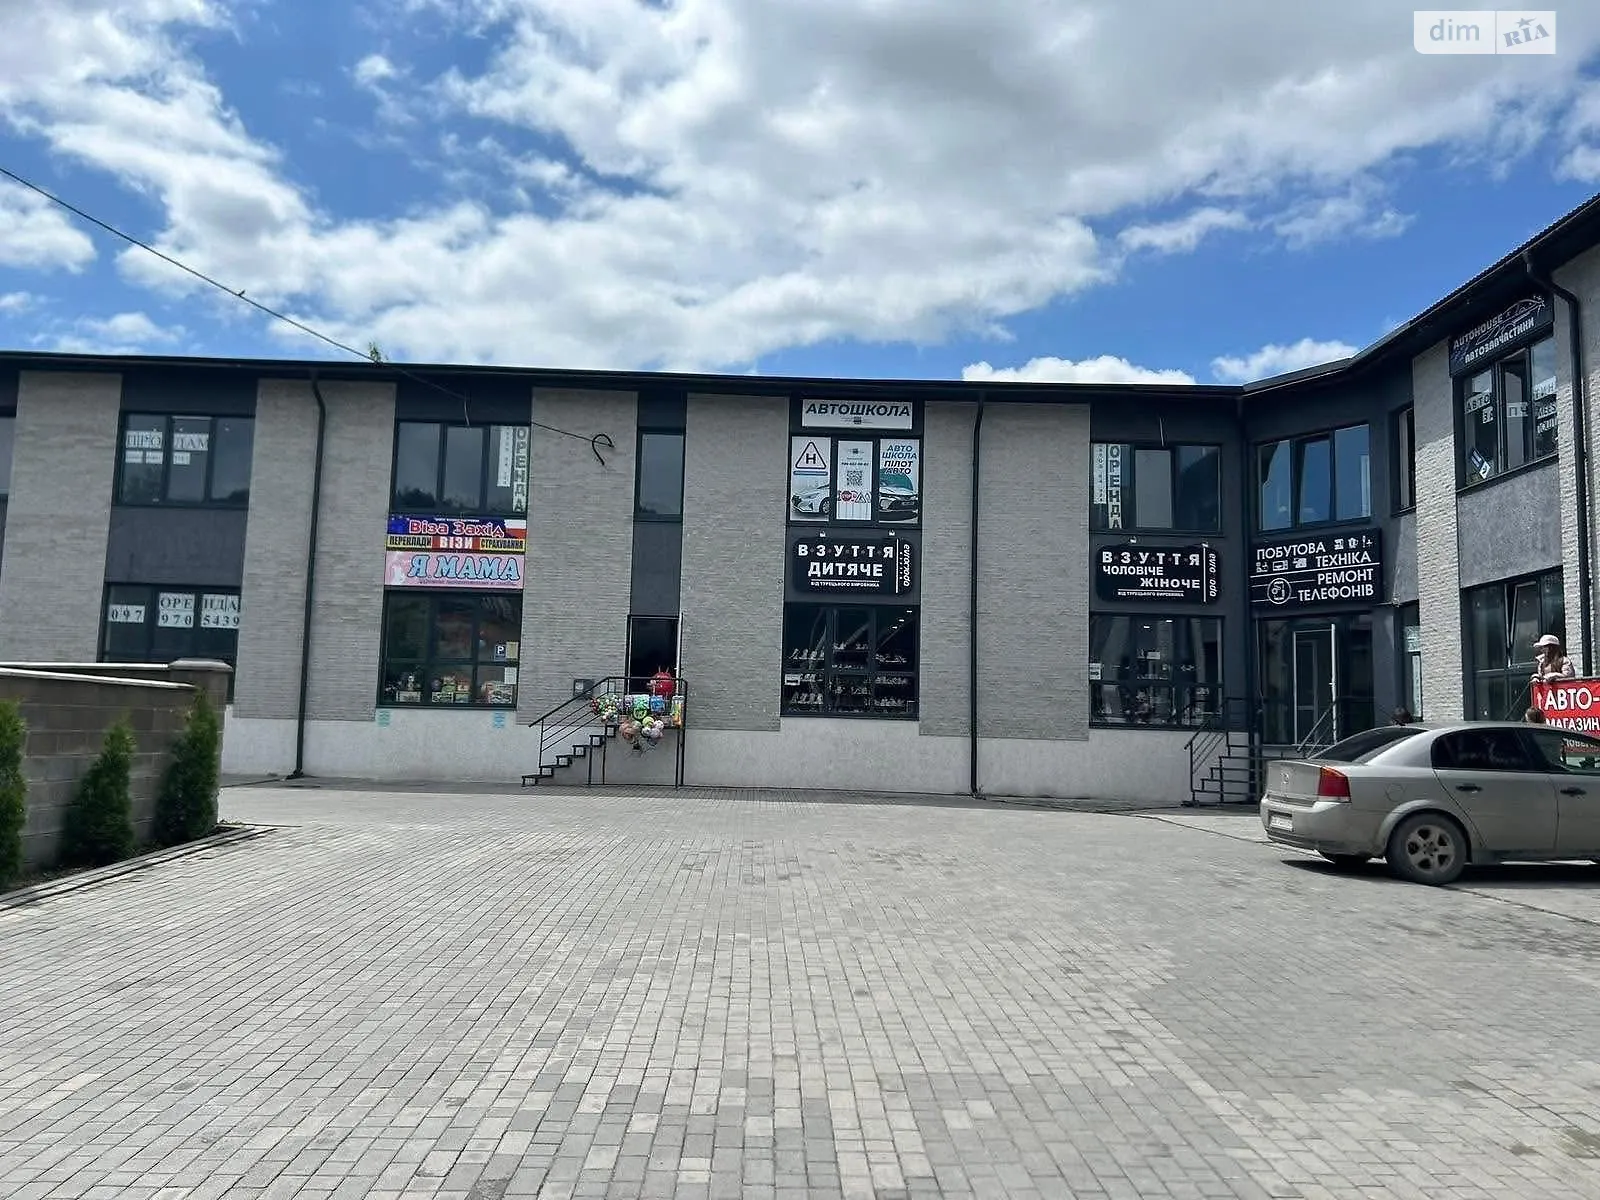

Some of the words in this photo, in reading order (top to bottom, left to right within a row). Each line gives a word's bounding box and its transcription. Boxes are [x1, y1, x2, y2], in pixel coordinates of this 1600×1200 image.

[1453, 313, 1504, 349] AUTOHOUSE
[1465, 317, 1535, 364] АВТОЗАПЧАСТИНИ
[806, 403, 910, 417] АВТОШКОЛА
[882, 452, 917, 460] ШКОЛА
[884, 460, 913, 468] ПІЛОТ
[1109, 445, 1121, 529] ОРЕНДА
[409, 520, 448, 535] Віза
[452, 519, 505, 538] Захід
[389, 536, 432, 547] ПЕРЕКЛАДИ
[439, 536, 473, 549] ВІЗИ
[481, 539, 523, 550] СТРАХУВАННЯ
[1257, 541, 1326, 560] ПОБУТОВА
[407, 555, 431, 579] Я
[434, 555, 520, 581] МАМА
[1315, 551, 1371, 568] ТЕХНІКА
[808, 562, 883, 577] ДИТЯЧЕ
[1103, 566, 1164, 576] ЧОЛОВІЧЕ
[1317, 568, 1374, 585] РЕМОНТ
[1140, 578, 1200, 589] ЖІНОЧЕ
[1298, 584, 1374, 602] ТЕЛЕФОНІВ
[111, 609, 142, 618] 097
[161, 615, 192, 625] 970
[203, 615, 239, 626] 5439
[1544, 687, 1600, 711] АВТО-
[1545, 717, 1600, 731] МАГАЗИН
